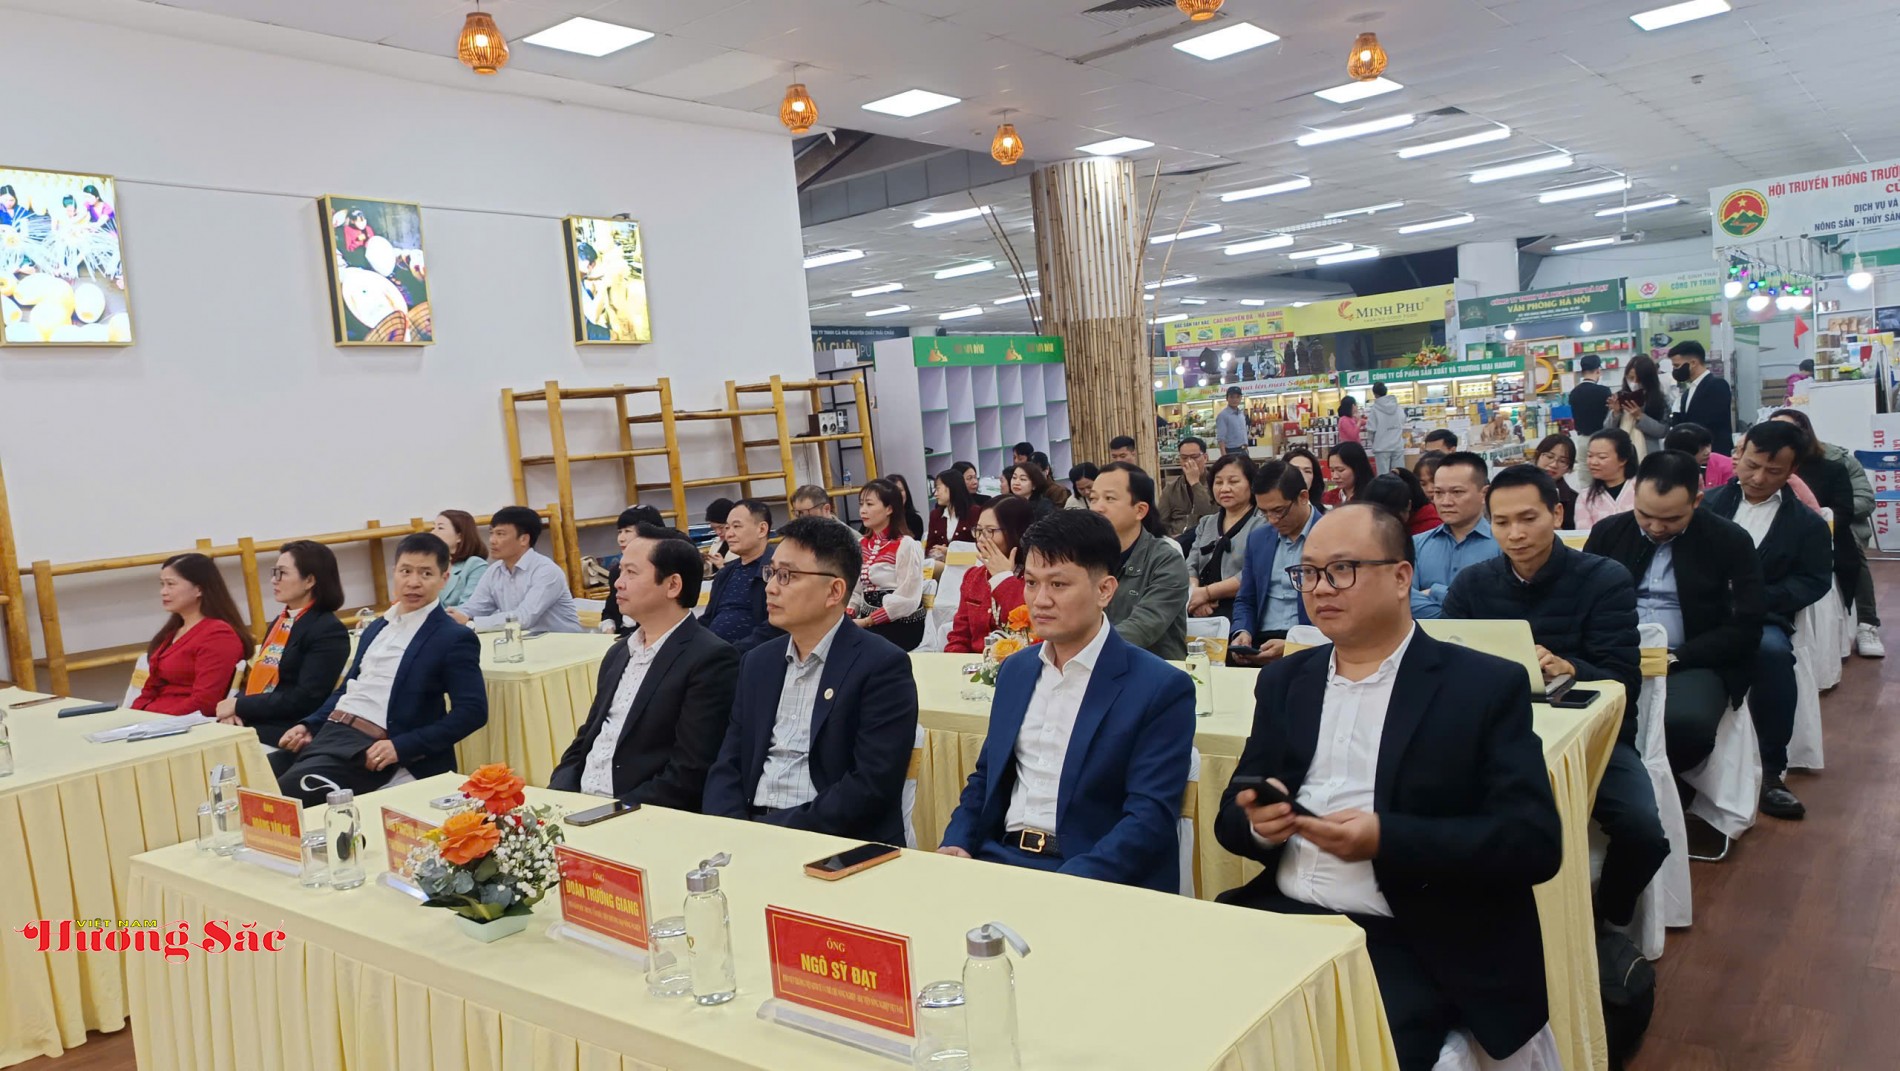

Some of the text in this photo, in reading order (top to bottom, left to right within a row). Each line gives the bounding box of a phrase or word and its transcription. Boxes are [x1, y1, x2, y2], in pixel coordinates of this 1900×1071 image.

[1768, 164, 1900, 198] HỘI TRUYỀN THỐNG TRƯỜ
[1854, 198, 1899, 214] DỊCH VỤ VÀ
[1814, 220, 1836, 231] NÔNG
[1839, 217, 1855, 229] SẢN
[1863, 213, 1882, 225] THỦY
[1884, 211, 1900, 222] SẢN
[1356, 306, 1392, 318] MINH
[1507, 295, 1591, 313] VĂN PHÒNG HÀ NỘI
[1372, 372, 1387, 380] CÔNG
[1395, 369, 1403, 378] CỔ
[1404, 369, 1419, 378] PHẦN
[1877, 513, 1889, 534] 174
[586, 887, 614, 908] TRƯỜNG
[615, 896, 639, 917] GIANG
[826, 937, 846, 952] ÔNG
[801, 953, 877, 991] NGÔ SỸ ĐẠT
